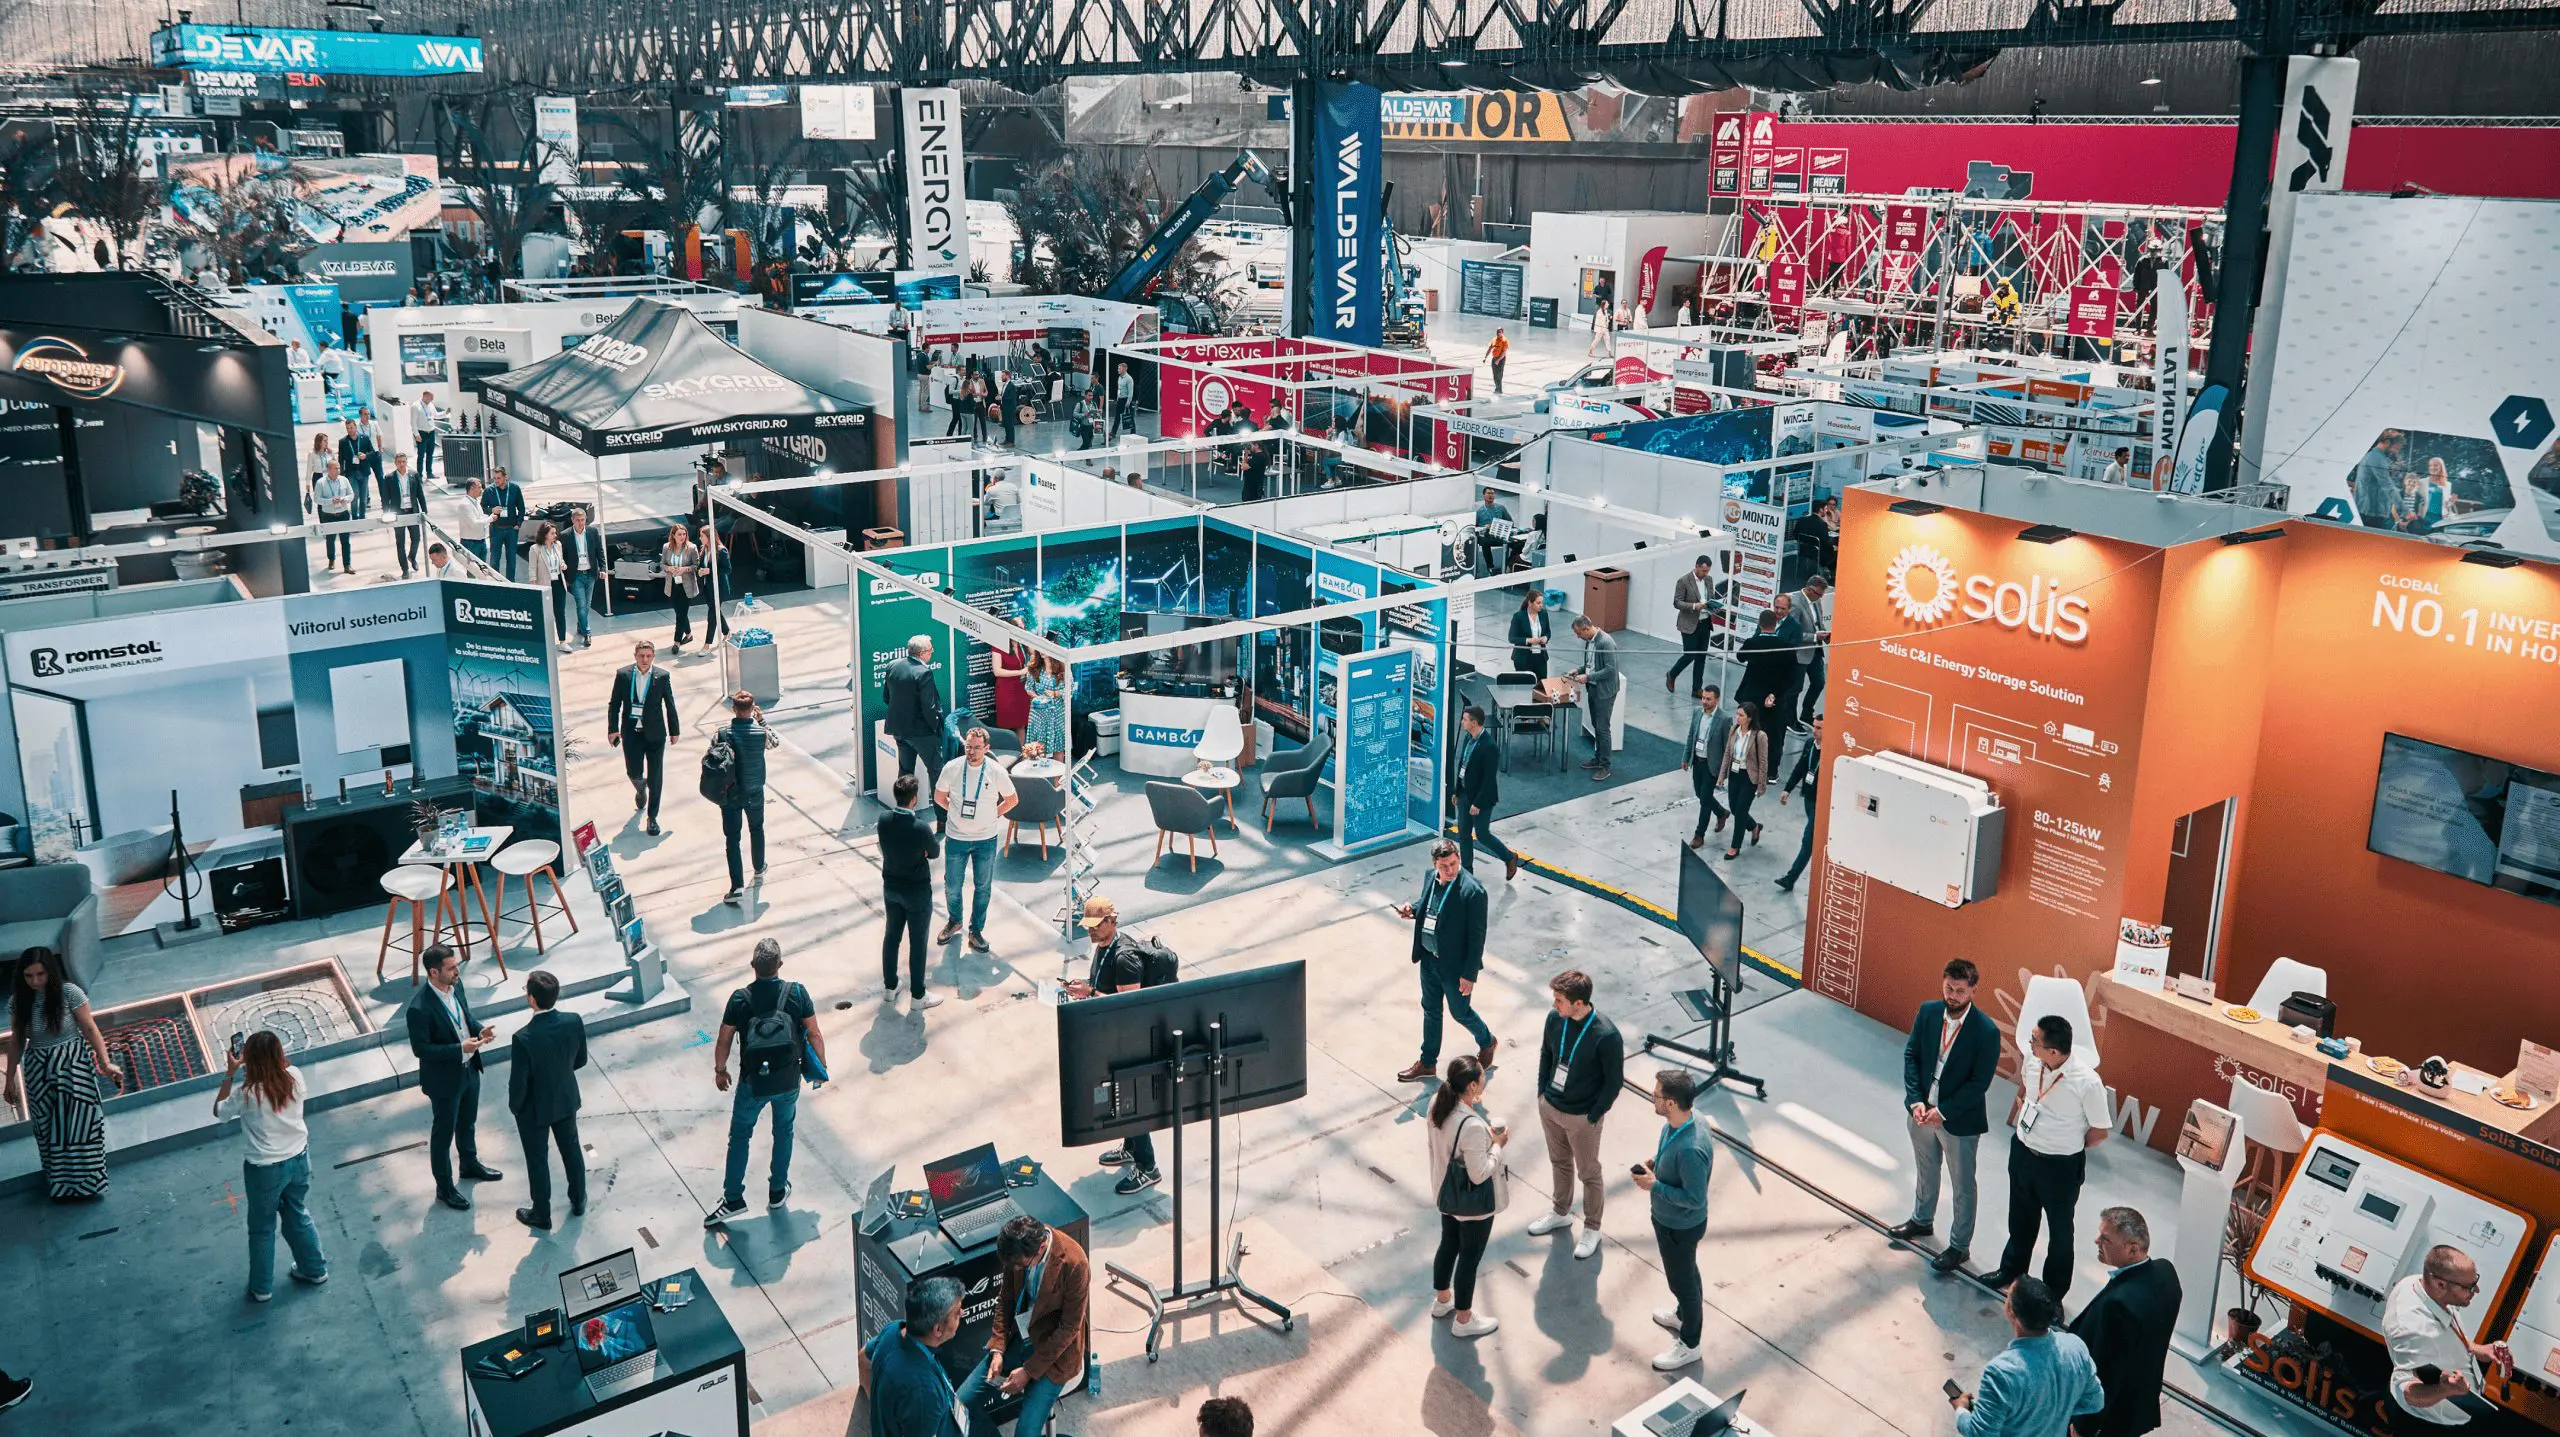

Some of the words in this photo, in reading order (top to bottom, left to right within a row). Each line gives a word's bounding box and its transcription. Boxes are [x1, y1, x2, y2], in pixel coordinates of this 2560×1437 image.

[918, 99, 952, 251] ENERGY
[1716, 177, 1734, 185] DUTY
[1717, 169, 1734, 177] HEAVY
[1813, 177, 1840, 188] HEAVY
[1335, 131, 1363, 330] WALDEVAR
[480, 338, 506, 350] Beta
[579, 334, 649, 367] SKYGRID
[1195, 345, 1262, 360] enexus
[643, 374, 786, 398] SKYGRID
[1553, 395, 1611, 414] LEADER
[691, 419, 788, 436] WWW.SKYGRID.RO
[815, 414, 865, 426] SKYGRID
[1452, 418, 1481, 433] LEADER
[1482, 424, 1504, 439] CABLE
[1553, 416, 1583, 429] SOLAR
[1827, 420, 1862, 432] Household
[606, 431, 664, 445] SKYGRID
[1742, 510, 1780, 528] MONTAJ
[1741, 527, 1767, 544] CLICK
[22, 575, 104, 592] TRANSFORMER
[2379, 573, 2442, 595] GLOBAL
[1963, 574, 2089, 643] solis
[2371, 590, 2480, 647] NO.1
[288, 616, 346, 637] Viitorul
[349, 605, 428, 630] sustenabil
[959, 615, 982, 635] RAMBOLL
[2486, 633, 2513, 655] IN
[2521, 640, 2560, 664] HO
[67, 663, 109, 674] UNIVERSUL
[515, 655, 540, 665] ENERGIE
[1879, 639, 1908, 658] Solis
[1909, 648, 1931, 664] C&I
[1933, 654, 1976, 679] Energy
[1977, 666, 2027, 691] Storage
[2029, 680, 2085, 706] Solution
[1135, 728, 1202, 744] RAMBOL
[2033, 809, 2102, 841] 80-125kW
[2032, 822, 2049, 832] Three
[2049, 828, 2067, 838] Phase
[2070, 835, 2084, 844] High
[2084, 839, 2105, 851] Voltage
[2247, 1071, 2297, 1103] solis
[2378, 1102, 2399, 1116] Single
[2399, 1109, 2420, 1123] Phase
[2424, 1119, 2440, 1132] Low
[2440, 1125, 2466, 1142] Voltage
[2478, 1126, 2517, 1149] Solis
[961, 1296, 1000, 1319] STRIX
[697, 1373, 729, 1393] ASUS
[2243, 1331, 2357, 1419] Solis
[2241, 1366, 2263, 1383] Works
[2263, 1378, 2280, 1392] with
[2287, 1391, 2304, 1405] Wide
[2306, 1401, 2328, 1418] Range
[2329, 1414, 2338, 1423] of
